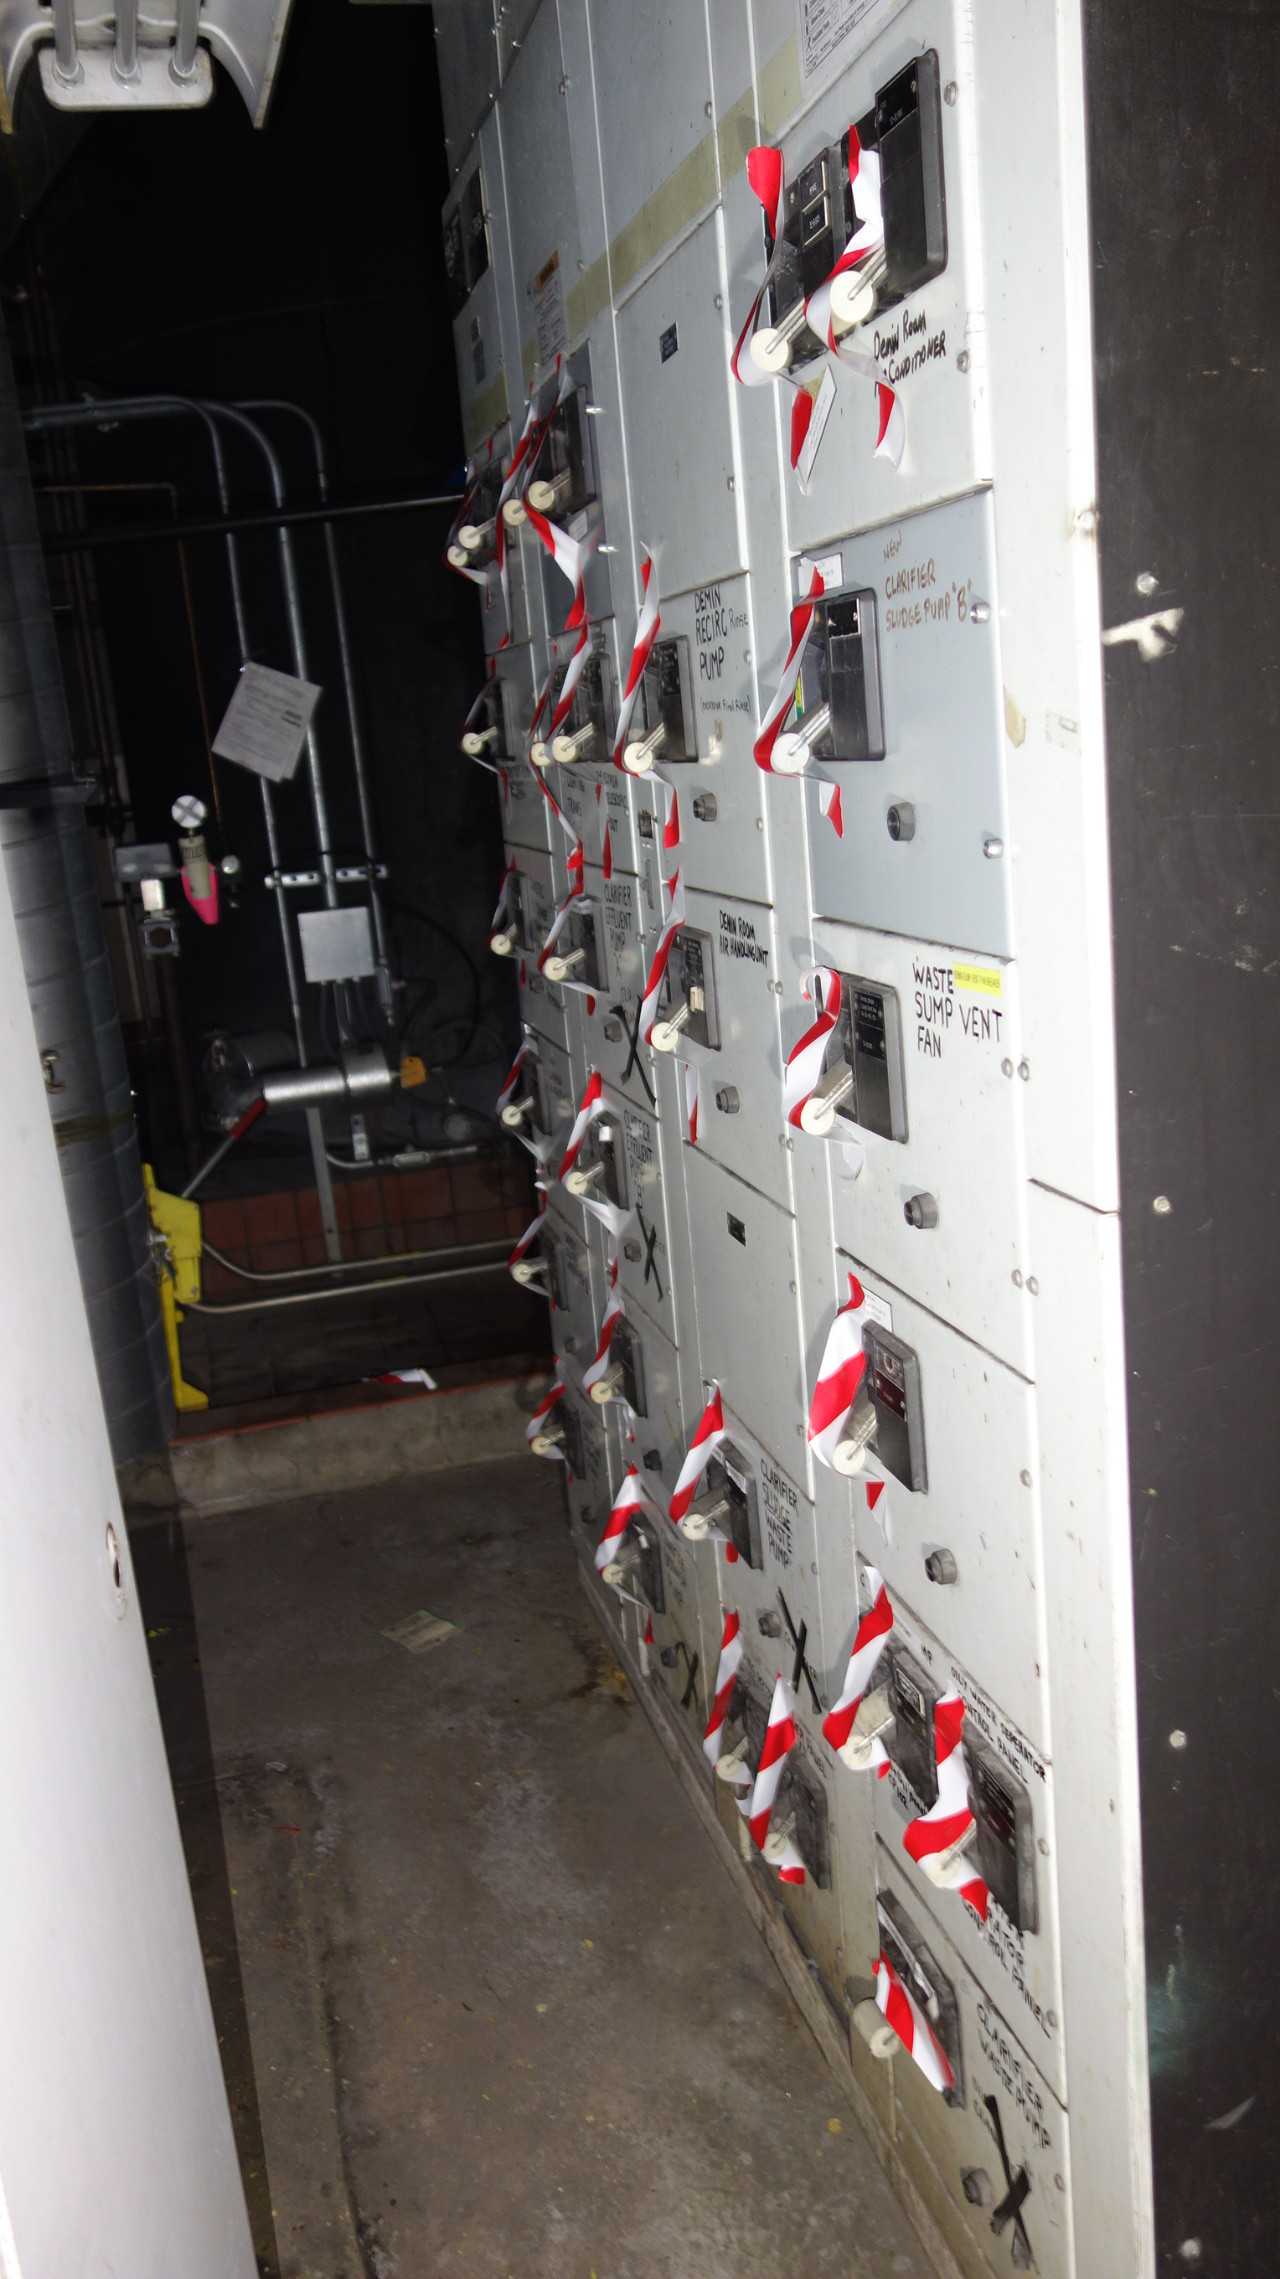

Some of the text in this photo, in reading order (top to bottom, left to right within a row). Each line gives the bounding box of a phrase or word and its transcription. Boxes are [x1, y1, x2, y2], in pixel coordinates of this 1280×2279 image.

[885, 558, 936, 599] CLARIFIER
[695, 584, 721, 613] DEMIN
[886, 602, 921, 632] SLUDGE
[924, 593, 951, 622] PUMP
[696, 608, 727, 646] RECIRC
[700, 646, 724, 680] PUMP
[912, 962, 954, 994] WASTE
[914, 991, 953, 1028] SUMP
[959, 1003, 1003, 1043] VENT
[917, 1026, 942, 1058] FAN
